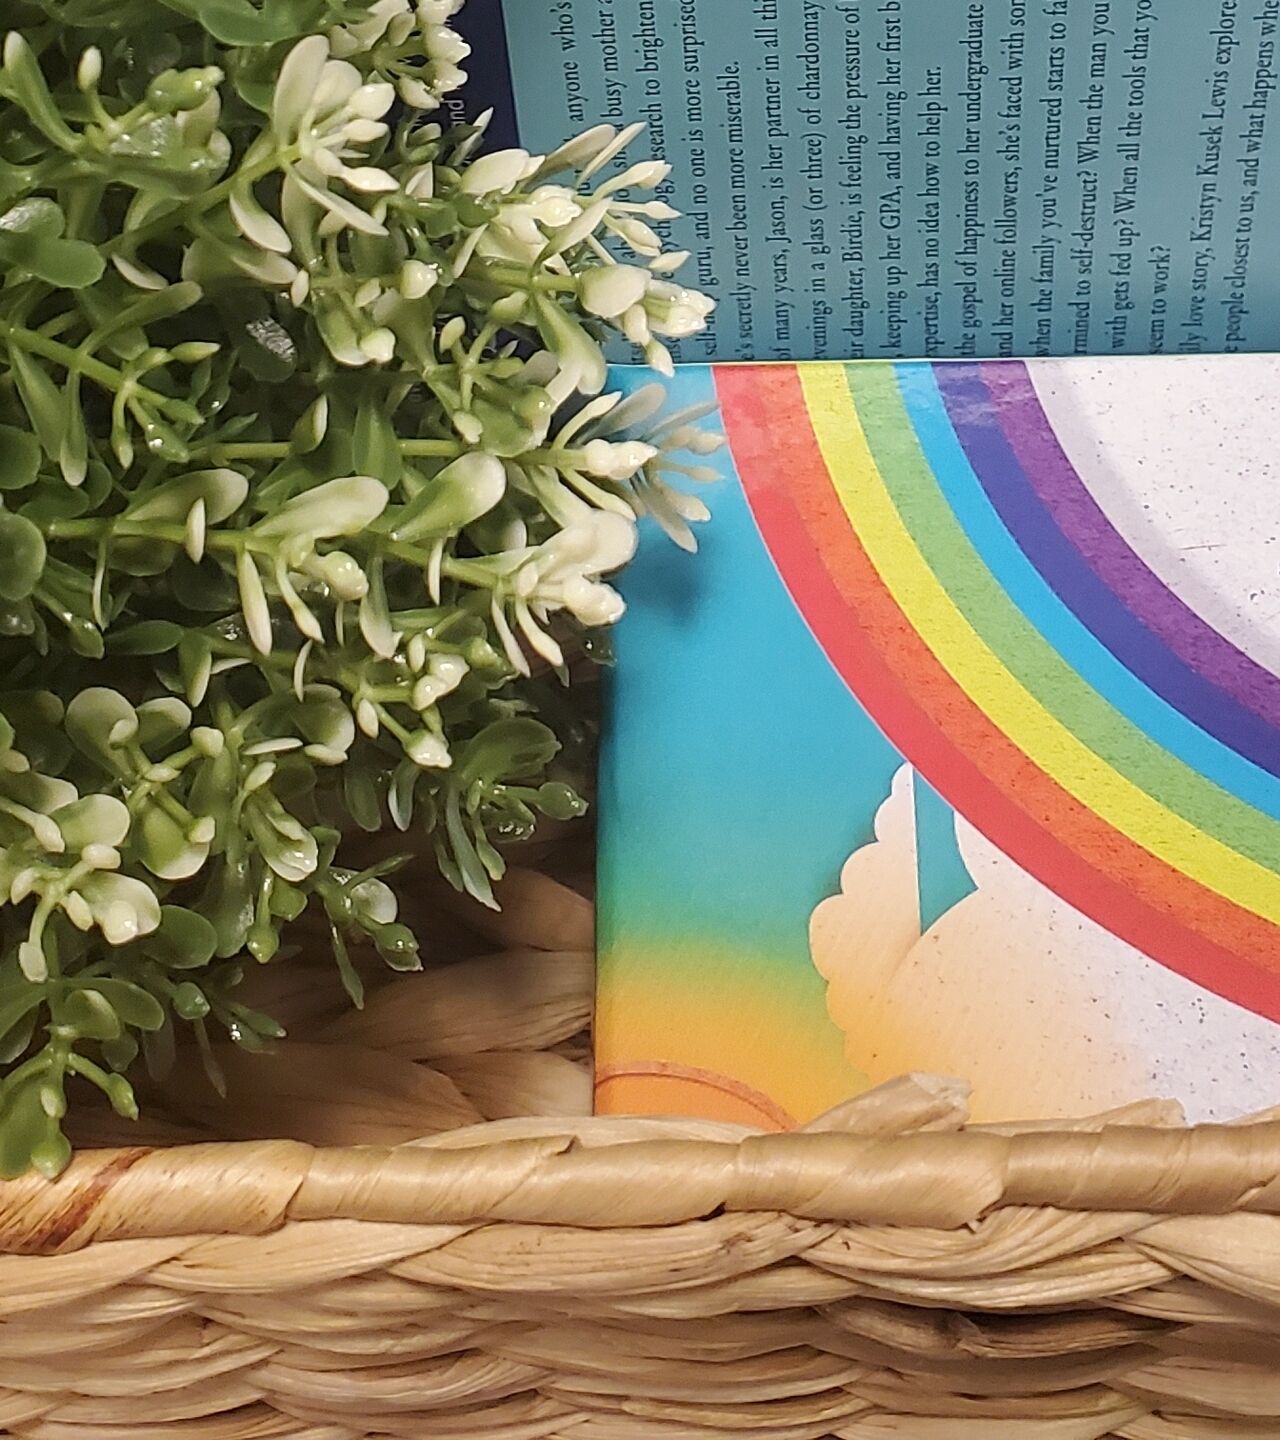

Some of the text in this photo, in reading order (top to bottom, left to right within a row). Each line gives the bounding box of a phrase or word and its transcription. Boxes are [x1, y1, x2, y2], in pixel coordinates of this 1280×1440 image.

[548, 1, 576, 51] who's
[591, 9, 619, 71] mother
[753, 27, 778, 48] all
[875, 17, 901, 52] first
[1123, 26, 1150, 60] that
[755, 54, 779, 71] in
[876, 57, 901, 85] her
[956, 3, 989, 123] undergraduate
[562, 61, 589, 121] anyone
[599, 77, 628, 117] busy
[684, 79, 702, 121] more
[1120, 65, 1147, 106] tools
[764, 77, 789, 137] partner
[876, 90, 908, 145] having
[680, 128, 703, 141] is
[1117, 111, 1143, 137] the
[760, 143, 783, 170] her
[955, 127, 980, 154] her
[1115, 142, 1141, 161] all
[689, 148, 706, 177] one
[876, 150, 901, 179] and
[963, 158, 979, 175] to
[691, 183, 708, 204] no
[761, 176, 784, 189] is
[1112, 166, 1138, 214] When
[715, 60, 758, 339] secretly never been more miserable.
[878, 185, 904, 230] GPA,
[684, 211, 710, 240] and
[764, 195, 792, 243] Jason,
[954, 180, 985, 255] happiness
[1112, 218, 1141, 247] up?
[877, 233, 901, 260] her
[695, 246, 717, 286] guru,
[771, 248, 795, 293] years,
[886, 265, 908, 286] up
[953, 259, 978, 276] of
[1107, 252, 1132, 276] fed
[952, 281, 984, 328] gospel
[1113, 280, 1135, 310] gets
[774, 299, 796, 341] many
[880, 290, 907, 348] keeping
[1105, 315, 1127, 347] with
[954, 333, 975, 355] the
